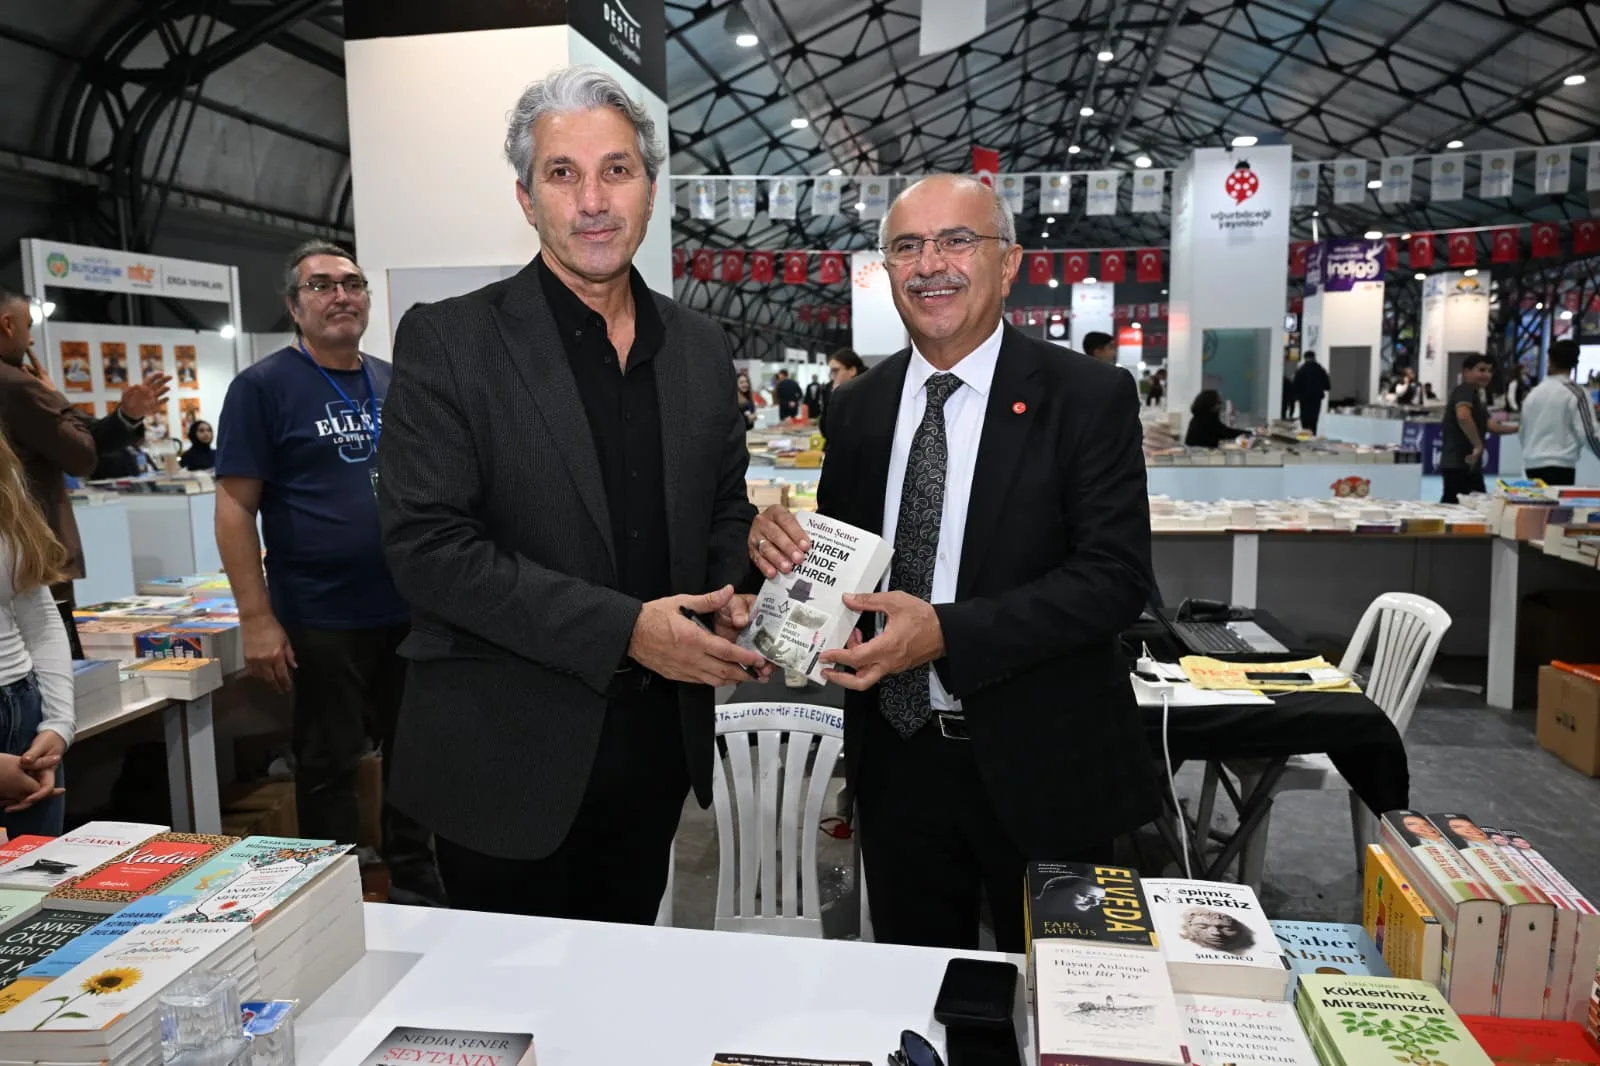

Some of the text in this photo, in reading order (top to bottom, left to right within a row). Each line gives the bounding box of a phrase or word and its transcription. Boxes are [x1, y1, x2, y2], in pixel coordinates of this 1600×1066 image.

[603, 2, 641, 50] DESTEK
[807, 518, 860, 544] Nedim Şener
[809, 539, 850, 563] AHREM
[802, 551, 838, 572] İNDE
[791, 564, 838, 588] AHREM
[1095, 865, 1146, 932] ELVEDA
[1165, 887, 1232, 899] epimiz
[1043, 920, 1080, 929] FARS
[1043, 928, 1097, 937] MEYUS
[1323, 986, 1431, 1002] Köklerimiz
[1322, 999, 1447, 1016] Mirasımızdır
[400, 1033, 510, 1050] NEDİM ŞENER
